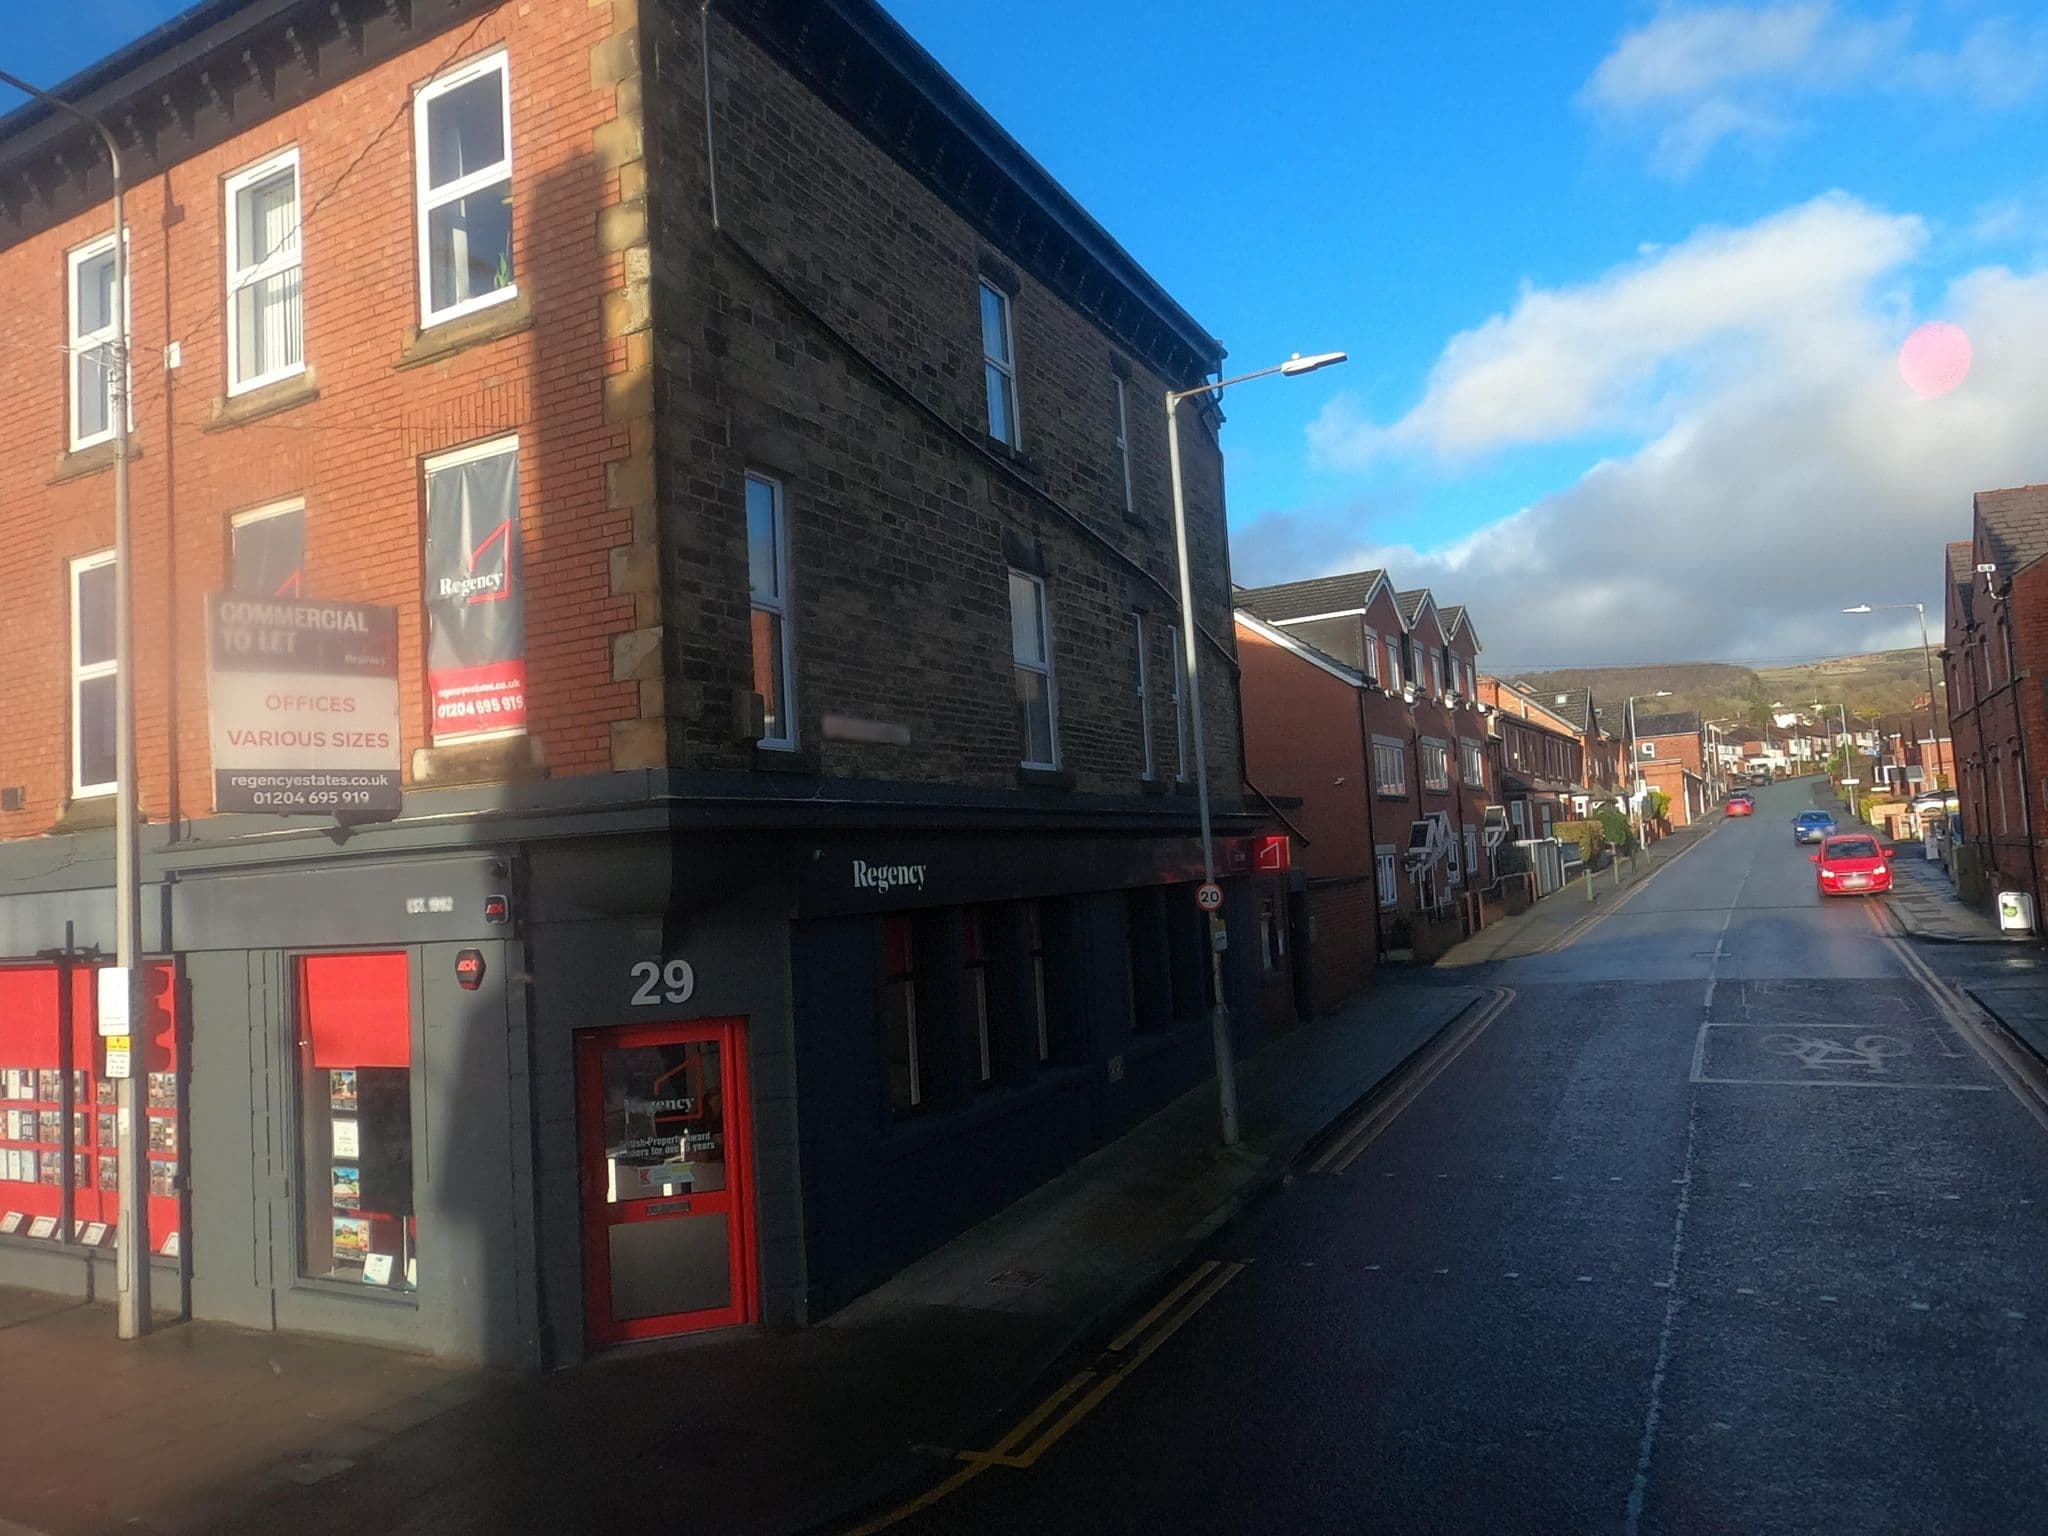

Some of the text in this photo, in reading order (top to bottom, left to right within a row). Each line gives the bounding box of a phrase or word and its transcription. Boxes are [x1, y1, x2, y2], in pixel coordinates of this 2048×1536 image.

[440, 572, 504, 596] Regency
[220, 602, 369, 632] COMMERCIAL
[223, 628, 297, 654] TO LET
[265, 694, 356, 713] OFFICES
[227, 730, 390, 748] VARIOUS SIZES
[231, 774, 389, 788] regencyestates.co.uk
[253, 791, 370, 805] 01204 695 919
[852, 859, 927, 894] Regency
[1200, 891, 1220, 903] 20
[630, 959, 694, 1006] 29
